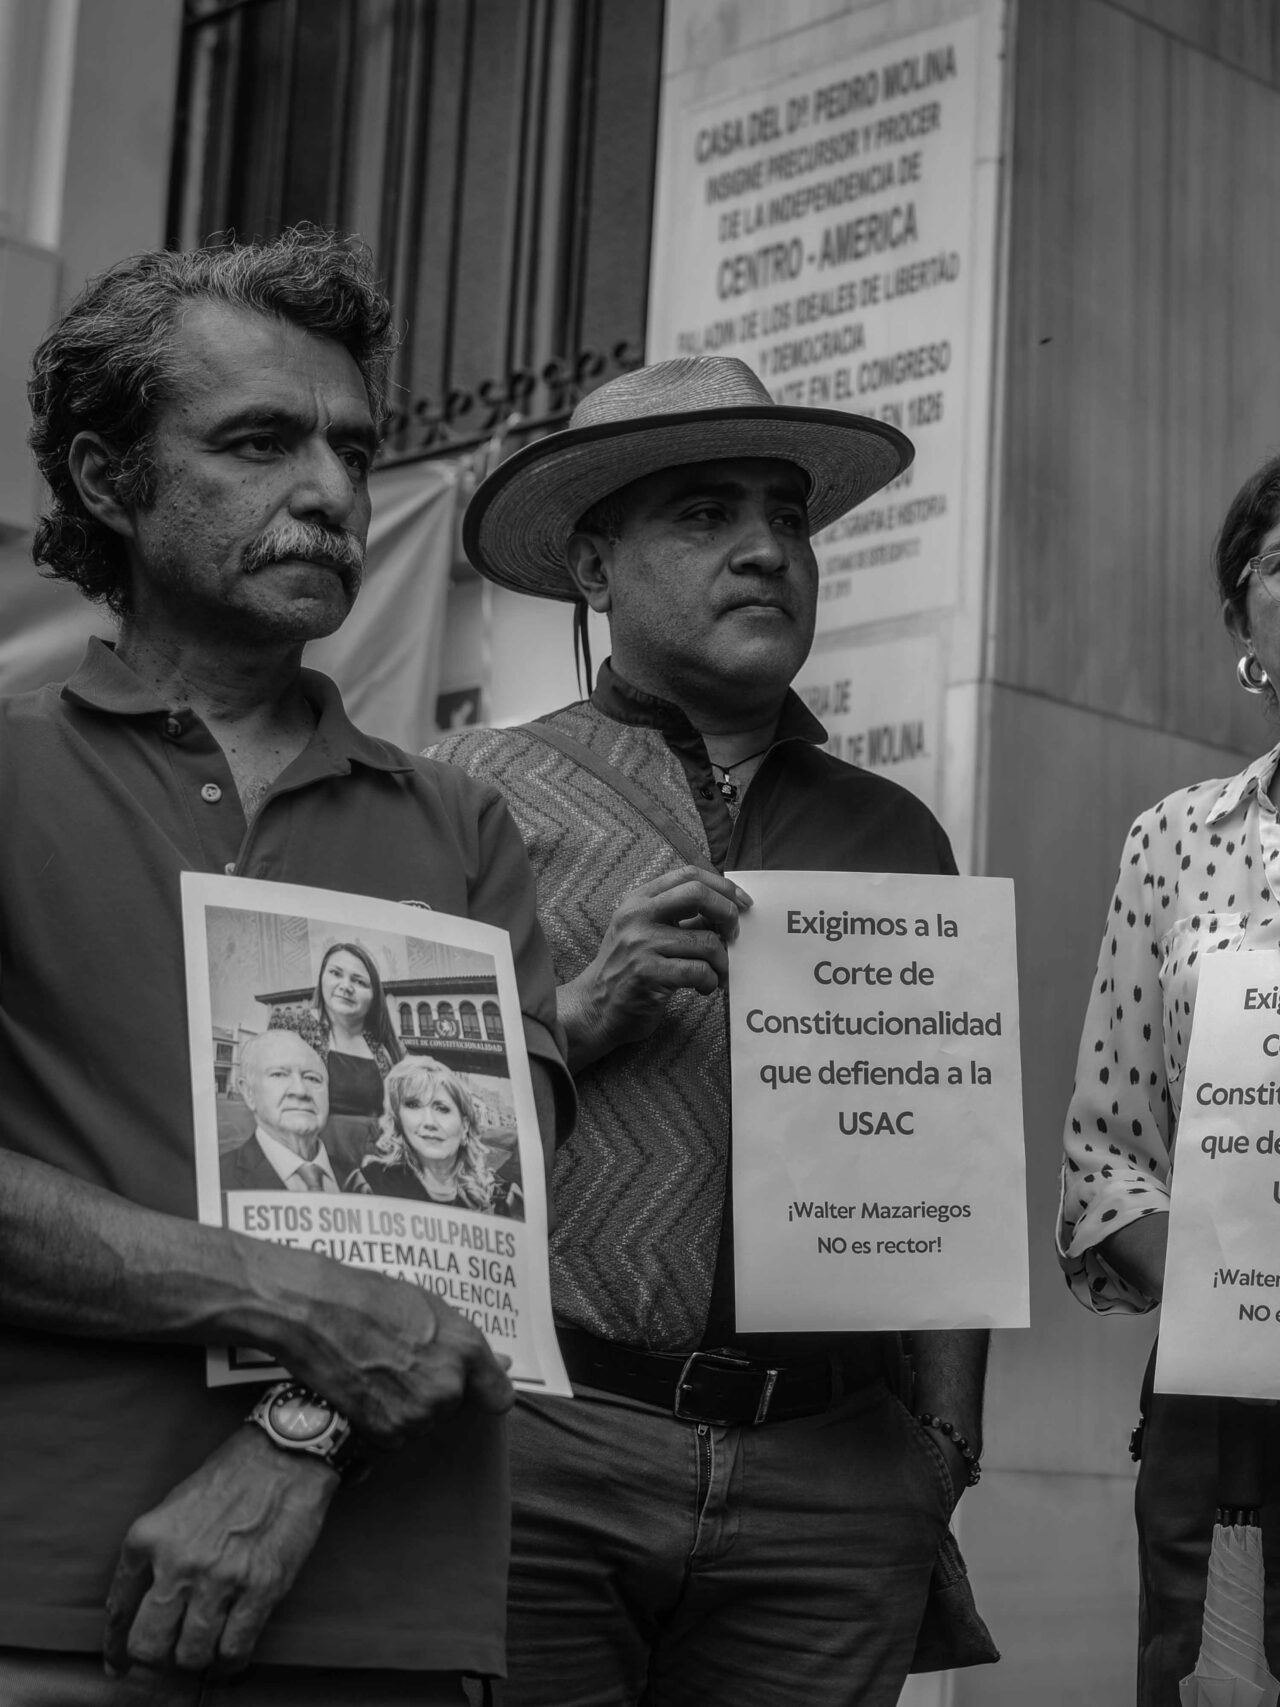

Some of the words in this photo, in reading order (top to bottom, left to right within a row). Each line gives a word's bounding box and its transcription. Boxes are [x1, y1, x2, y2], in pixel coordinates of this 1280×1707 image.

[694, 117, 744, 164] CASA
[747, 105, 783, 146] DEL
[812, 69, 878, 125] PEDRO
[881, 45, 957, 102] MOLINA
[705, 159, 763, 206] INSIGNE
[765, 127, 859, 185] PRECURSOR
[861, 124, 873, 154] Y
[718, 208, 741, 244] DE
[744, 202, 765, 236] LA
[768, 161, 895, 226] INDEPENDENCIA
[899, 149, 922, 186] DE
[739, 309, 759, 343] DE
[761, 301, 792, 337] LOS
[796, 282, 858, 327] IDEALES
[860, 273, 882, 308] DE
[884, 250, 961, 301] LIBERTAD
[770, 322, 865, 376] DEMOCRACIA
[833, 368, 853, 400] EL
[856, 339, 952, 395] CONGRESO
[833, 679, 852, 716] DE
[787, 910, 908, 942] Exigimos
[915, 919, 930, 937] a
[937, 914, 959, 938] la
[813, 961, 893, 986] Corte
[900, 960, 935, 986] de
[746, 1009, 1002, 1037] Constitucionalidad
[760, 1064, 812, 1090] que
[818, 1060, 940, 1086] defienda
[948, 1067, 963, 1086] a
[971, 1060, 992, 1086] la
[838, 1111, 915, 1136] USAC
[1200, 1136, 1250, 1160] que
[788, 1202, 856, 1222] ¡Walter
[861, 1203, 972, 1223] Mazariegos
[243, 1205, 313, 1232] ESTOS
[318, 1206, 362, 1235] SON
[367, 1209, 406, 1238] LOS
[411, 1214, 517, 1258] CULPABLES
[818, 1237, 847, 1254] NO
[851, 1241, 872, 1254] es
[876, 1237, 943, 1254] rector!
[311, 1239, 460, 1274] GUATEMALA
[468, 1256, 517, 1288] SIGA
[1238, 1304, 1271, 1322] NO
